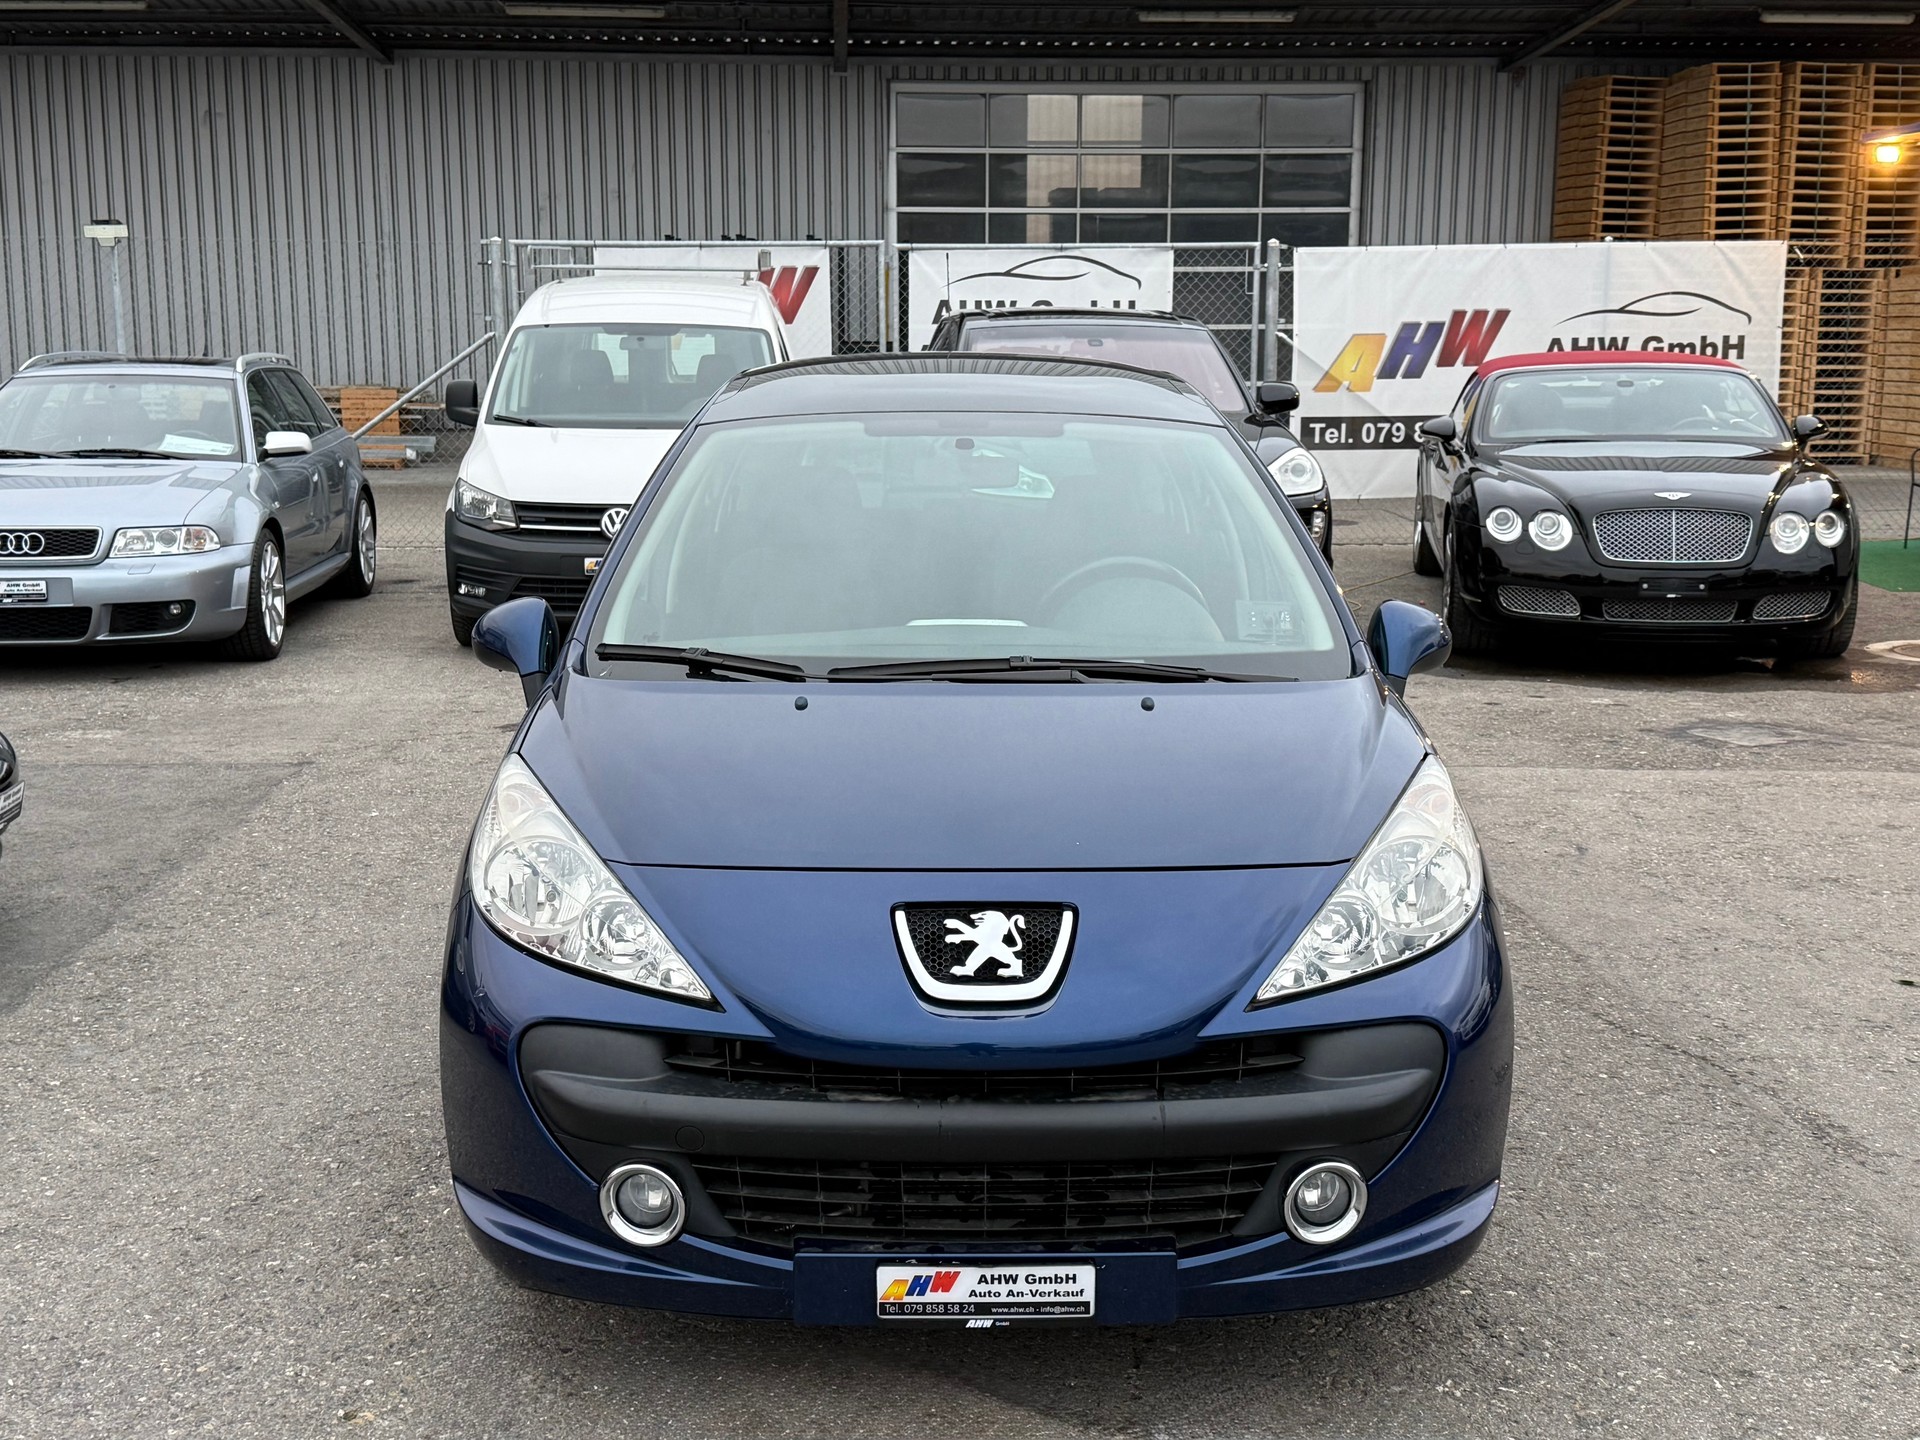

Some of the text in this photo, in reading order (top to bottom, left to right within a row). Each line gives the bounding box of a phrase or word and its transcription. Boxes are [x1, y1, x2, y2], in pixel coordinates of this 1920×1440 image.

[1312, 308, 1511, 392] AHW
[1309, 423, 1354, 443] Tel.
[1361, 423, 1406, 443] 079
[977, 1273, 1078, 1285] AHW GmbH
[880, 1271, 961, 1300] AHW
[968, 1288, 1085, 1298] Auto An-Verkauf
[884, 1304, 975, 1313] Tel. 079 858 58 24
[991, 1305, 1035, 1313] www.ahw.ch
[1040, 1305, 1085, 1314] info@ahw.ch
[965, 1319, 994, 1328] AHW
